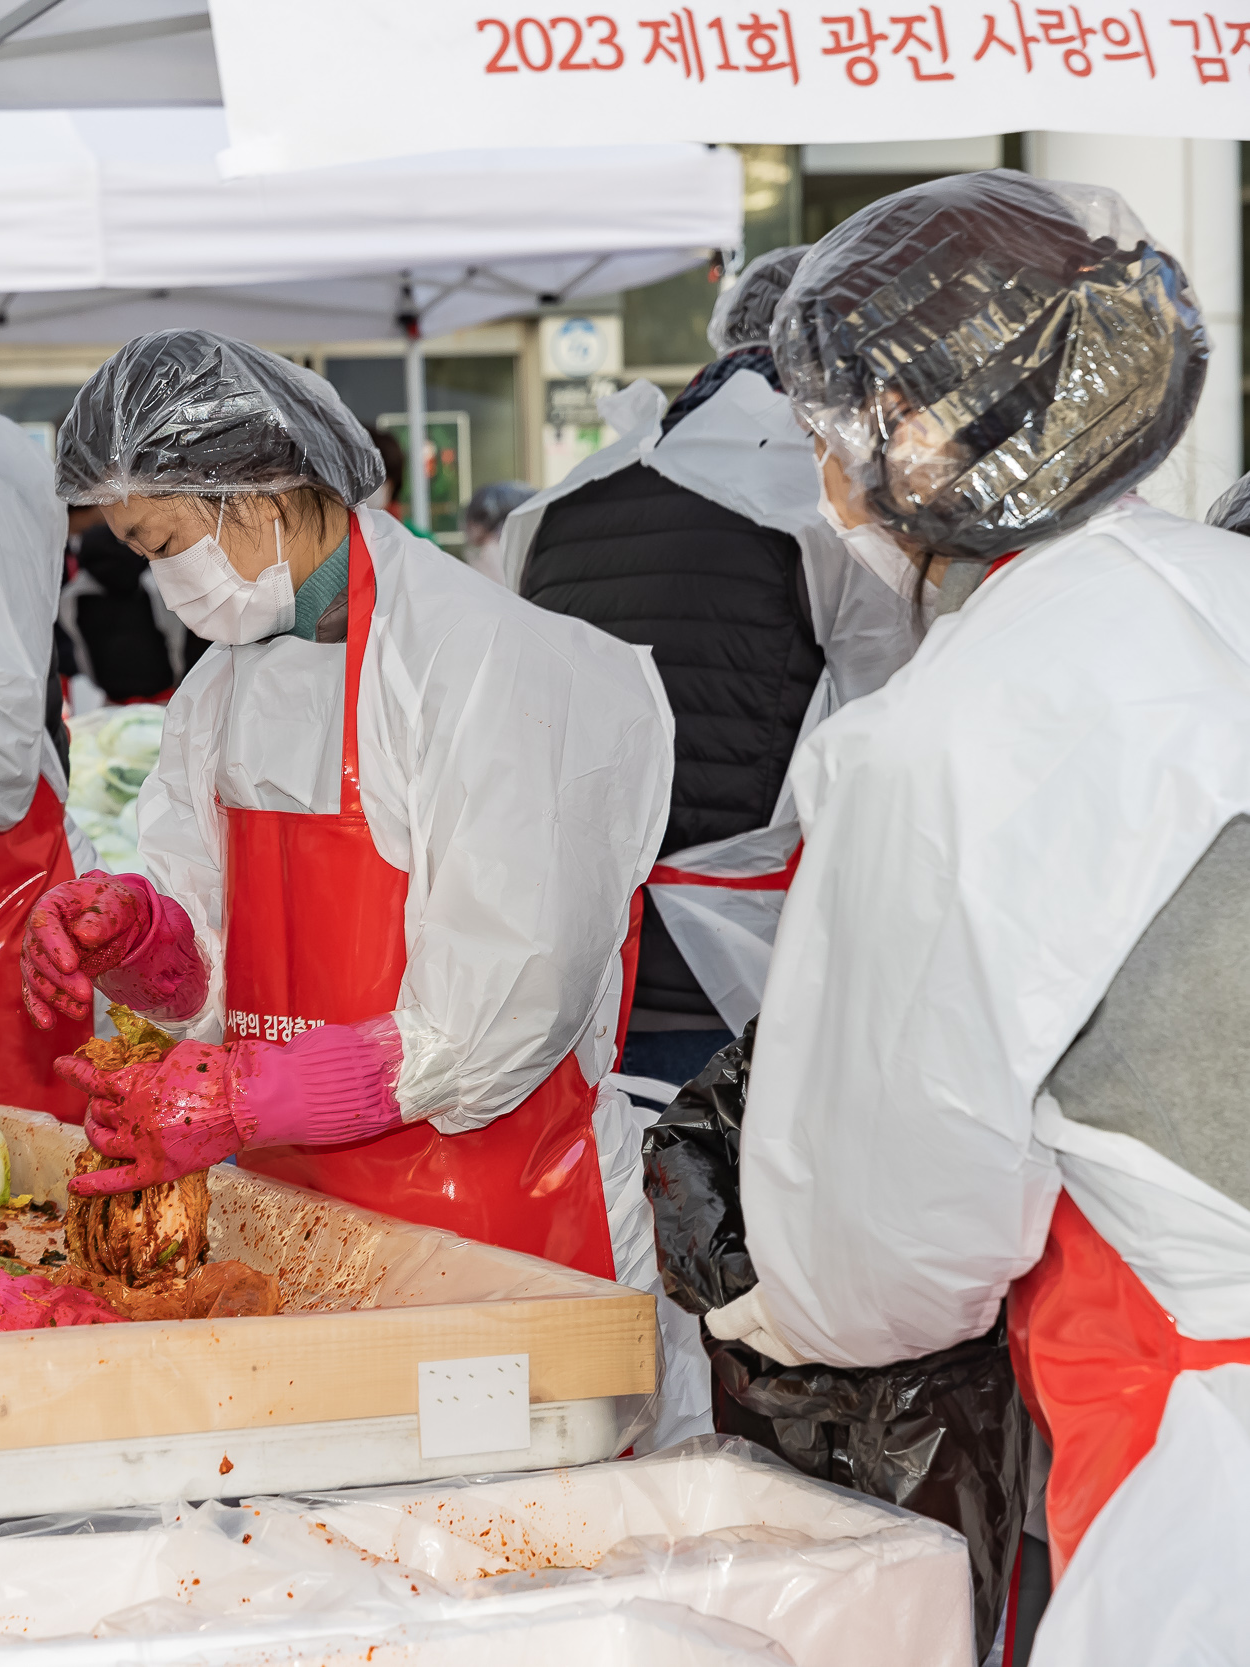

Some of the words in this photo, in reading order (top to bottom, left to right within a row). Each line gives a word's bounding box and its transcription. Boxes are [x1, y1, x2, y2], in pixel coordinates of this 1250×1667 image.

[476, 15, 624, 73] 2023
[638, 7, 799, 85] 제1회
[821, 5, 955, 86] 광진
[974, 0, 1156, 79] 사랑의
[227, 1009, 260, 1037] 사랑의
